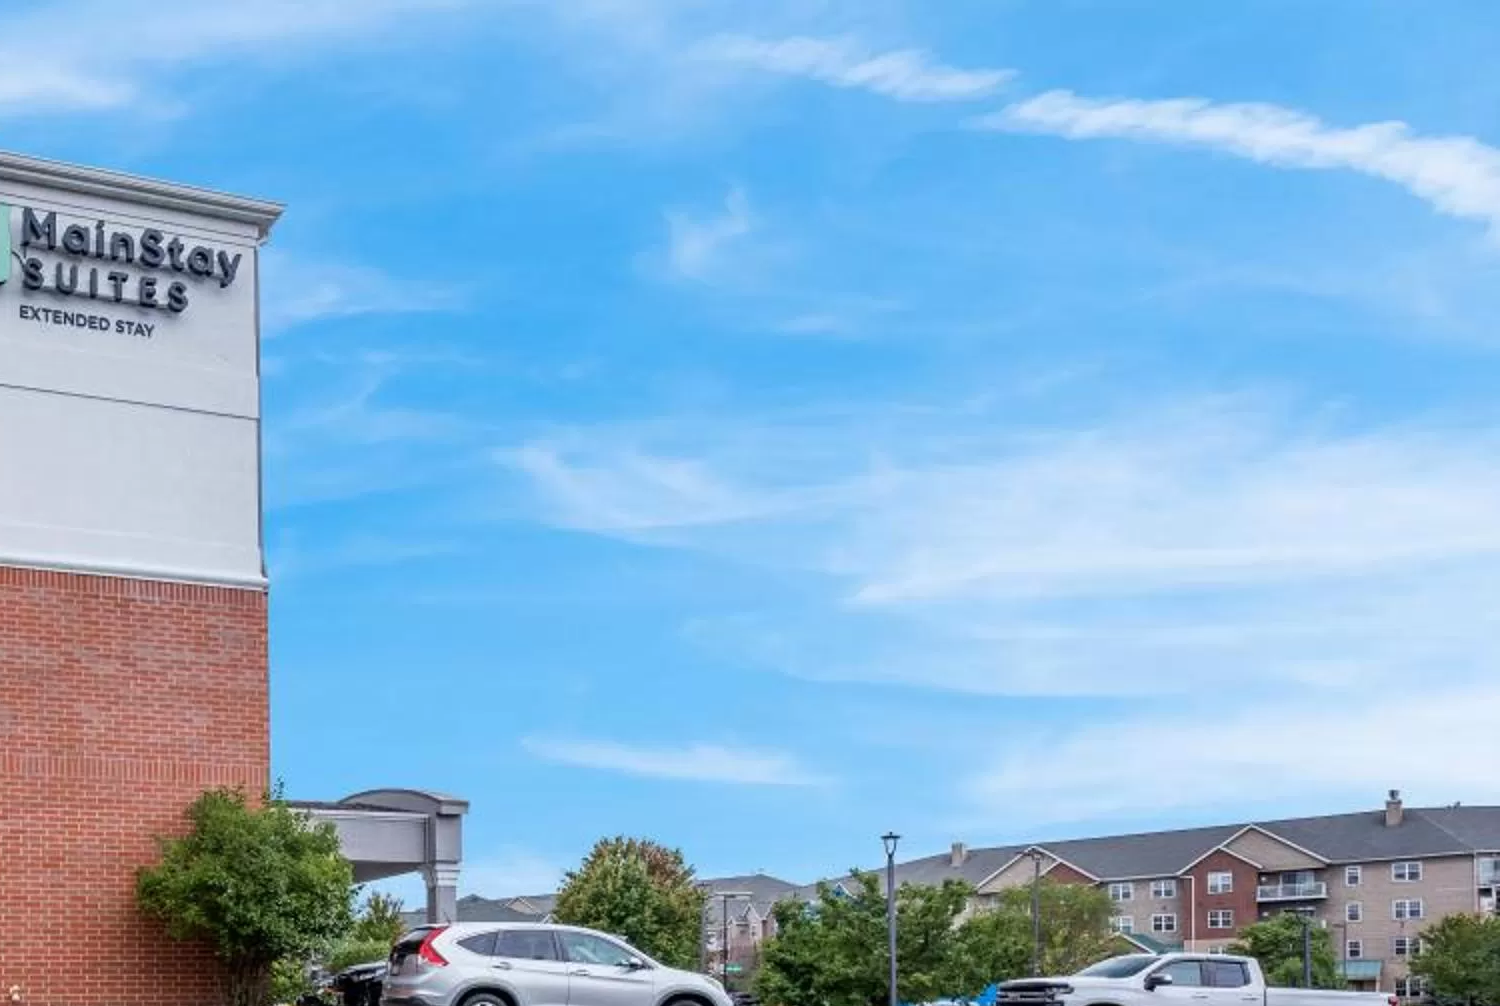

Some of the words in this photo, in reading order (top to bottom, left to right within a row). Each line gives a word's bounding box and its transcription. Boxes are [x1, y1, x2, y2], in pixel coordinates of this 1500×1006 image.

[22, 207, 241, 288] MainStay
[21, 257, 189, 313] SUITES
[20, 305, 110, 331] EXTENDED
[115, 319, 154, 337] STAY
